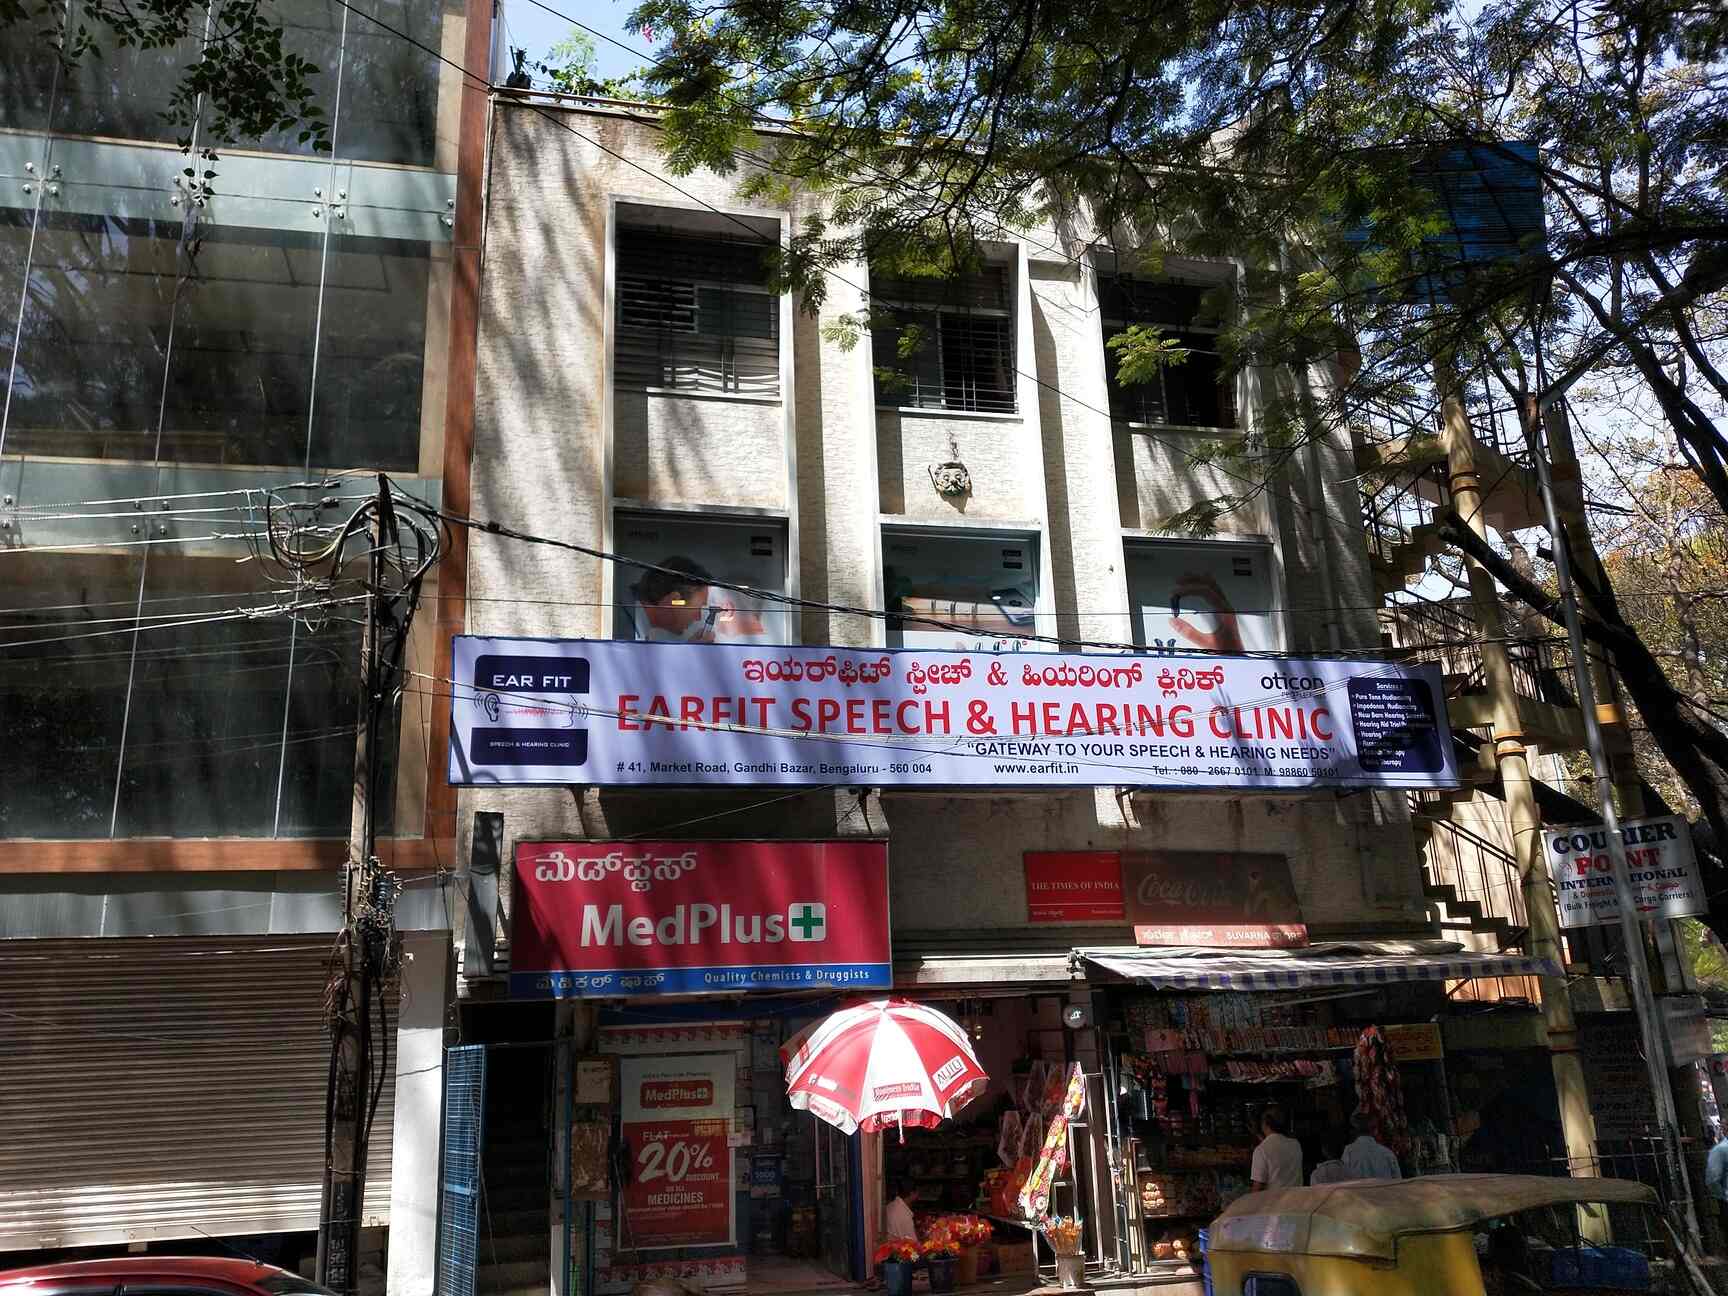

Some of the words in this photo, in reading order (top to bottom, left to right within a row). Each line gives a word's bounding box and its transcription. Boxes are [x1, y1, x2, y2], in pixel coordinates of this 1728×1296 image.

[492, 674, 534, 688] EAR
[542, 675, 572, 689] FIT
[986, 661, 1009, 687] &
[1022, 661, 1143, 689] ಹಿಯರಿಂಗ್
[1260, 672, 1325, 691] oticon
[617, 694, 776, 732] EARFIT
[790, 697, 951, 735] SPEECH
[966, 699, 998, 736] &
[1011, 701, 1195, 738] HEARING
[1208, 705, 1333, 741] CLINIC
[1055, 742, 1077, 756] TO
[1080, 743, 1125, 757] YOUR
[1129, 744, 1190, 758] SPEECH
[1195, 745, 1206, 758] &
[1209, 745, 1276, 760] HEARING
[616, 762, 625, 772] #
[628, 762, 646, 774] 41,
[650, 762, 692, 773] Market
[695, 762, 730, 775] Road,
[734, 763, 777, 773] Gandhi
[780, 763, 816, 775] Bazar,
[819, 764, 879, 776] Bengaluru
[889, 764, 909, 774] 560
[912, 764, 932, 774] 004
[994, 762, 1080, 774] www.earfit.in
[1207, 766, 1231, 777] 2667
[1234, 767, 1258, 777] 0101
[1279, 767, 1309, 777] 98860
[1574, 847, 1662, 876] PONT
[1031, 882, 1051, 891] THE
[1051, 881, 1078, 890] TIMES
[1078, 881, 1093, 890] OF
[1094, 880, 1120, 890] INDIA
[579, 903, 786, 947] MedPlus
[1226, 930, 1270, 941] SUVARNA
[704, 971, 746, 985] Quality
[750, 969, 801, 982] Chemists
[804, 970, 812, 980] &
[816, 968, 870, 982] Druggists
[646, 1085, 698, 1102] MedPlus
[642, 1129, 670, 1142] FLAT
[637, 1141, 713, 1184] 20%
[647, 1192, 704, 1206] MEDICINES
